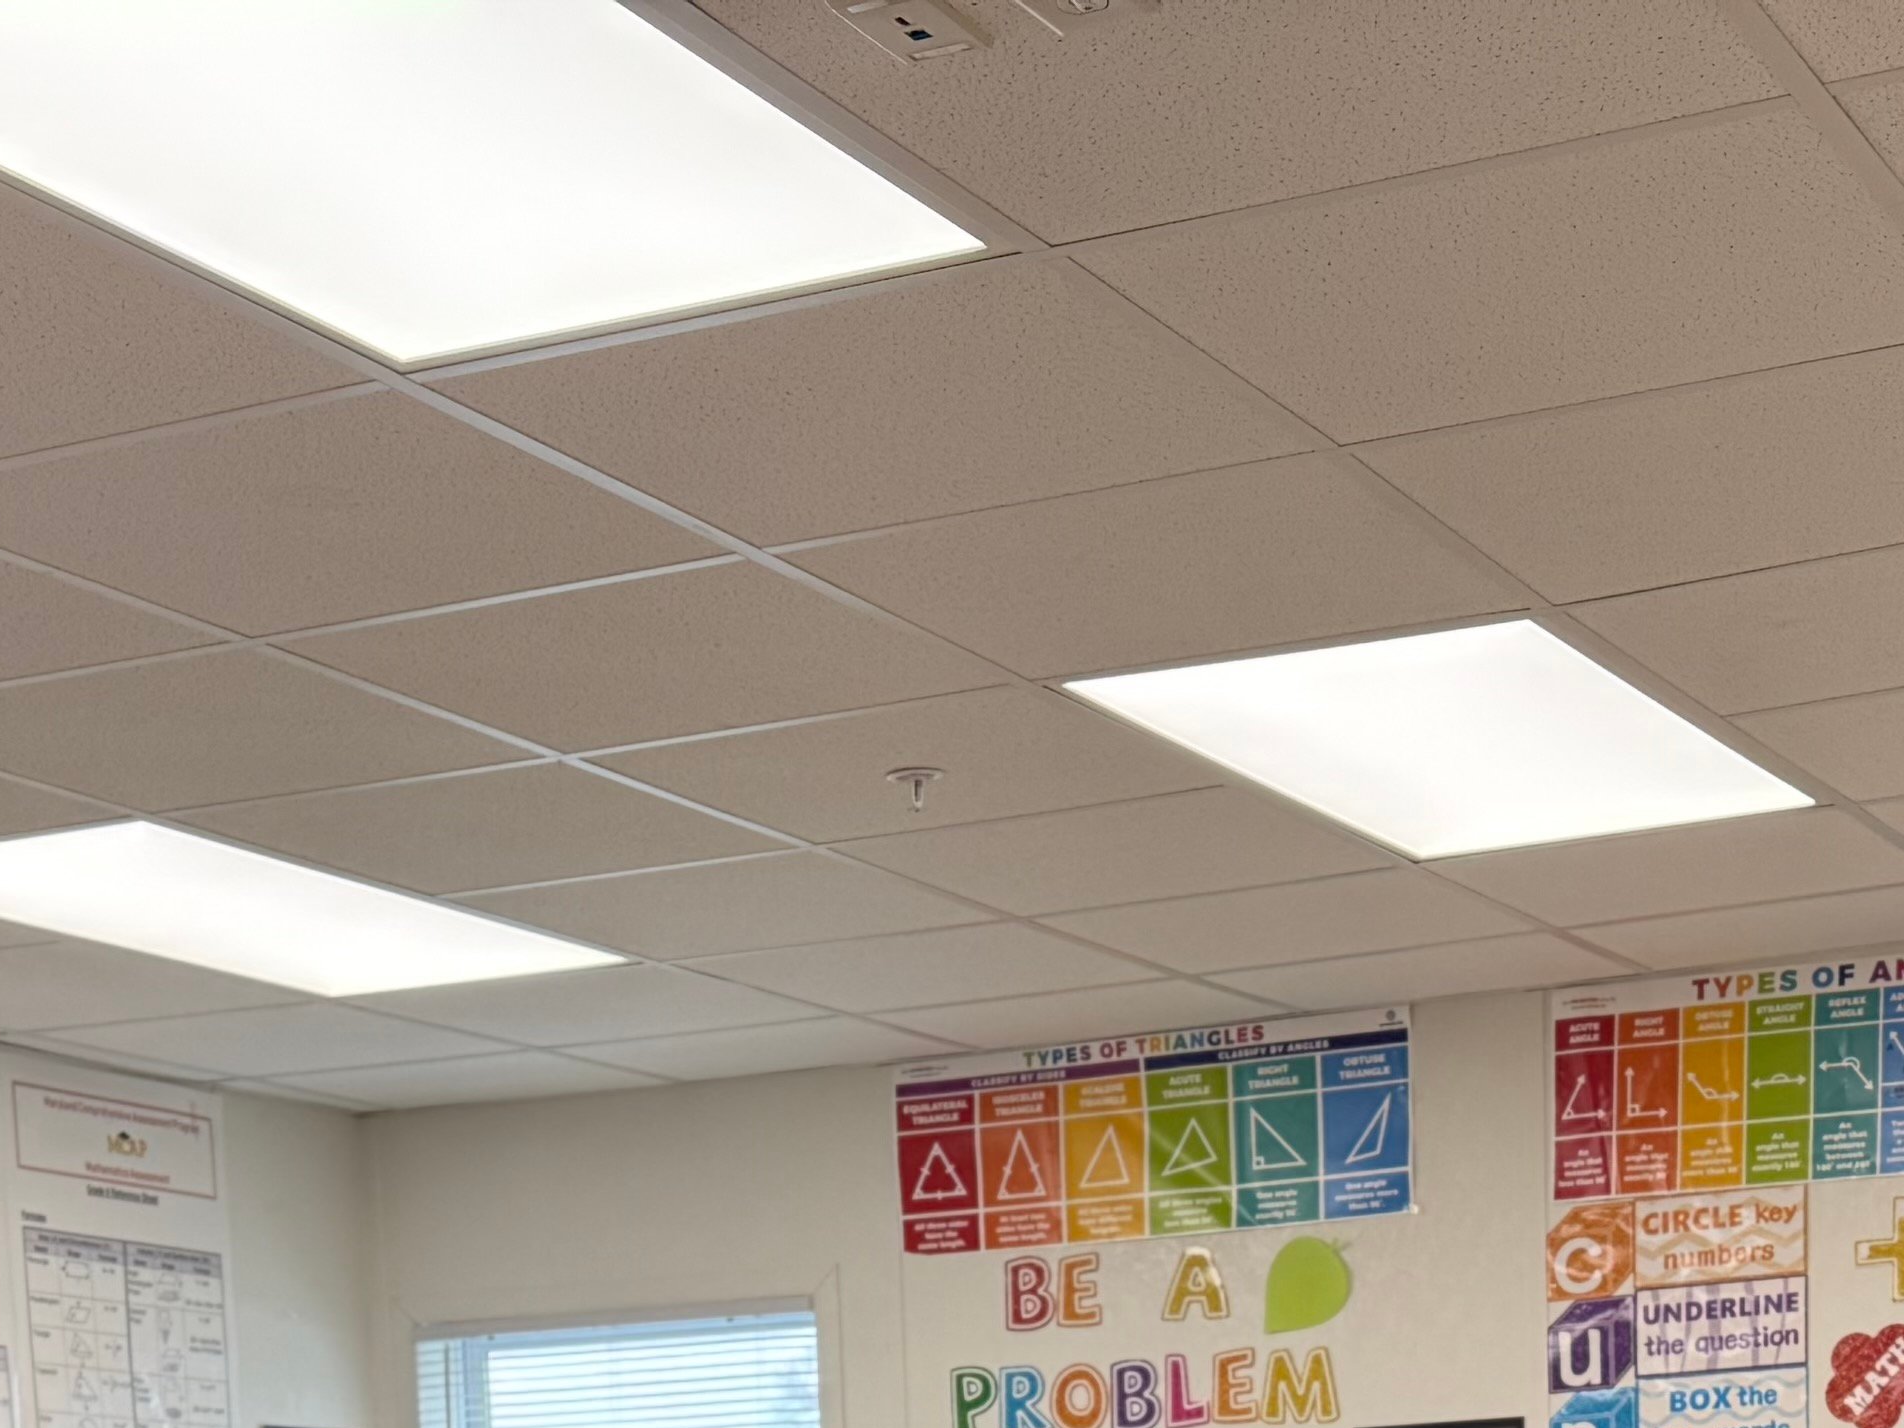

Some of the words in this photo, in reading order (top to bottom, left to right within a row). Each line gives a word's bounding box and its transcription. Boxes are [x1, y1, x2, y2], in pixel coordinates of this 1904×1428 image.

[1692, 968, 1798, 1001] TYPES
[1812, 964, 1856, 988] OF
[1023, 1045, 1092, 1068] TYPES
[1099, 1040, 1128, 1059] OF
[1136, 1024, 1265, 1055] TRIANGLES
[1641, 1204, 1744, 1236] CIRCLE
[1755, 1202, 1798, 1226] key
[1554, 1236, 1603, 1294] C
[1663, 1242, 1776, 1271] numbers
[1004, 1252, 1103, 1332] BE
[1160, 1245, 1230, 1322] A
[1642, 1292, 1800, 1324] UNDERLINE
[1644, 1336, 1685, 1356] the
[1695, 1327, 1799, 1353] question
[1670, 1386, 1732, 1413] BOX
[1737, 1386, 1778, 1406] the
